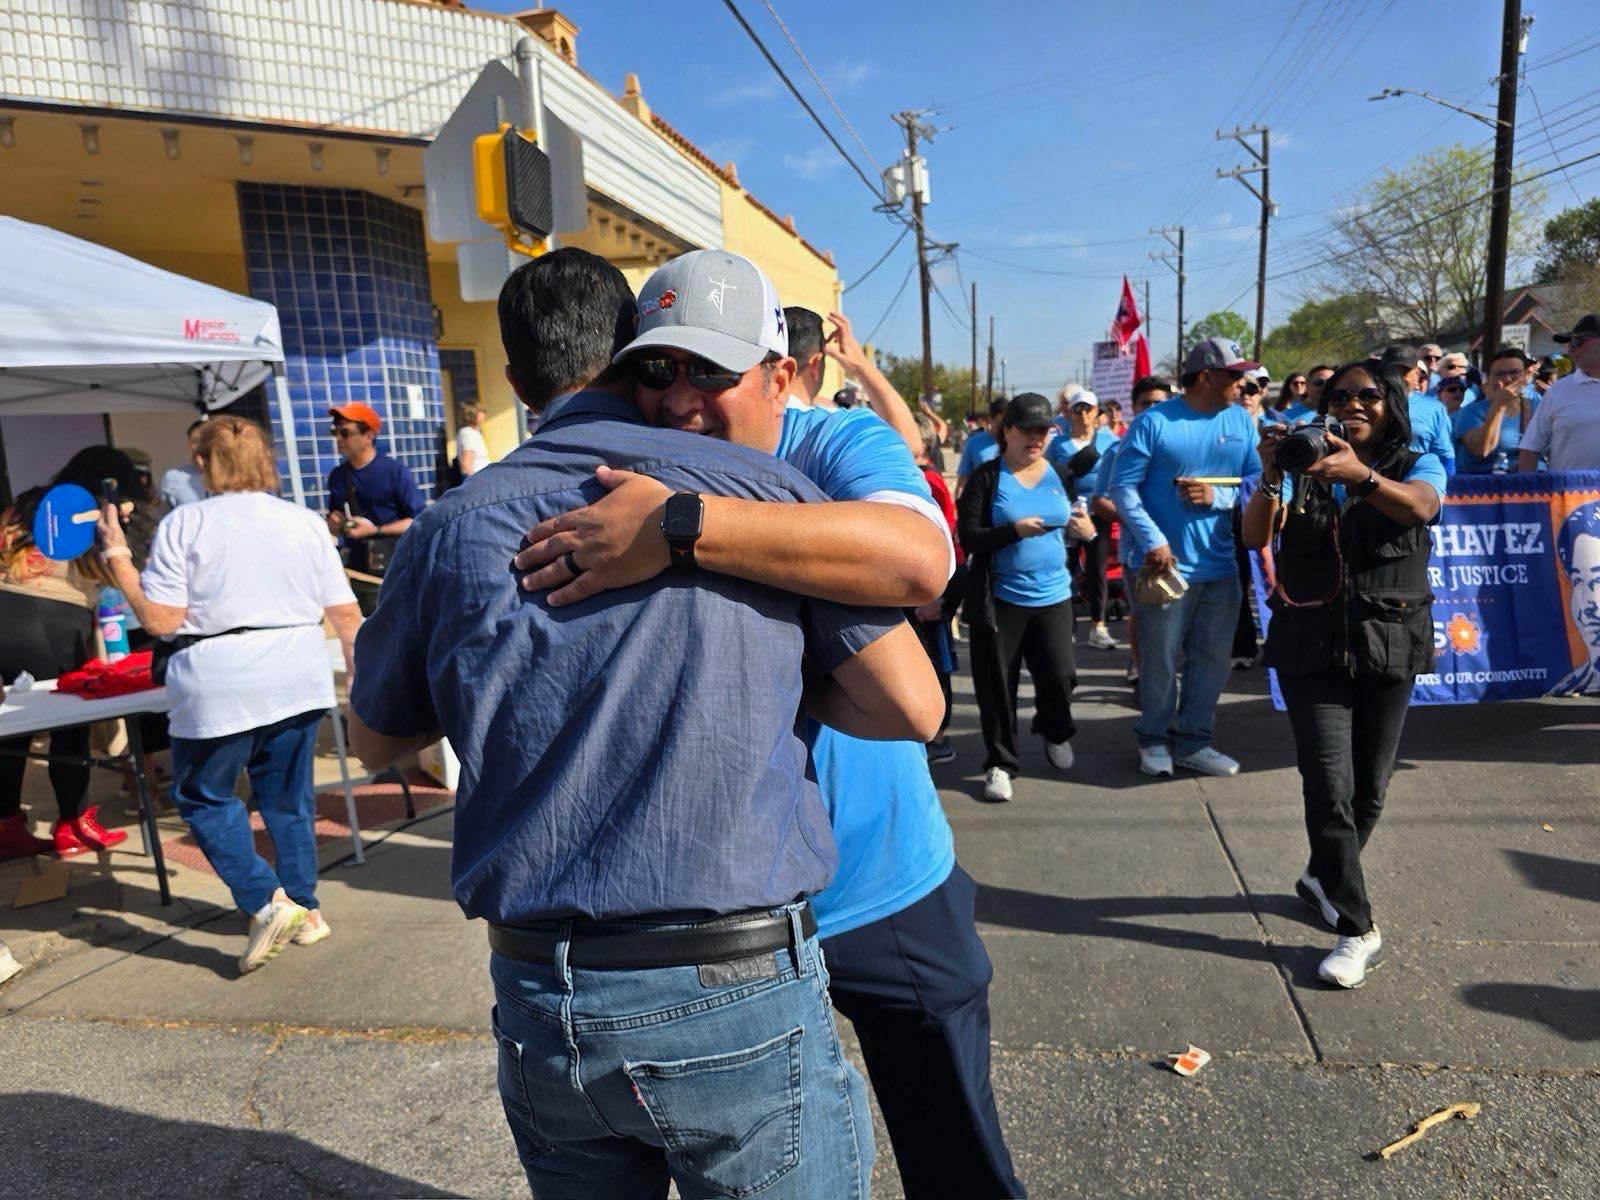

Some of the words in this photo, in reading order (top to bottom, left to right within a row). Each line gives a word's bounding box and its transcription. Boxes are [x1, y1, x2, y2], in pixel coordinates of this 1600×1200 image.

[1430, 523, 1544, 557] HAVEZ
[1449, 564, 1528, 592] JUSTICE
[1444, 672, 1474, 685] OUR
[1475, 668, 1547, 683] COMMUNITY
